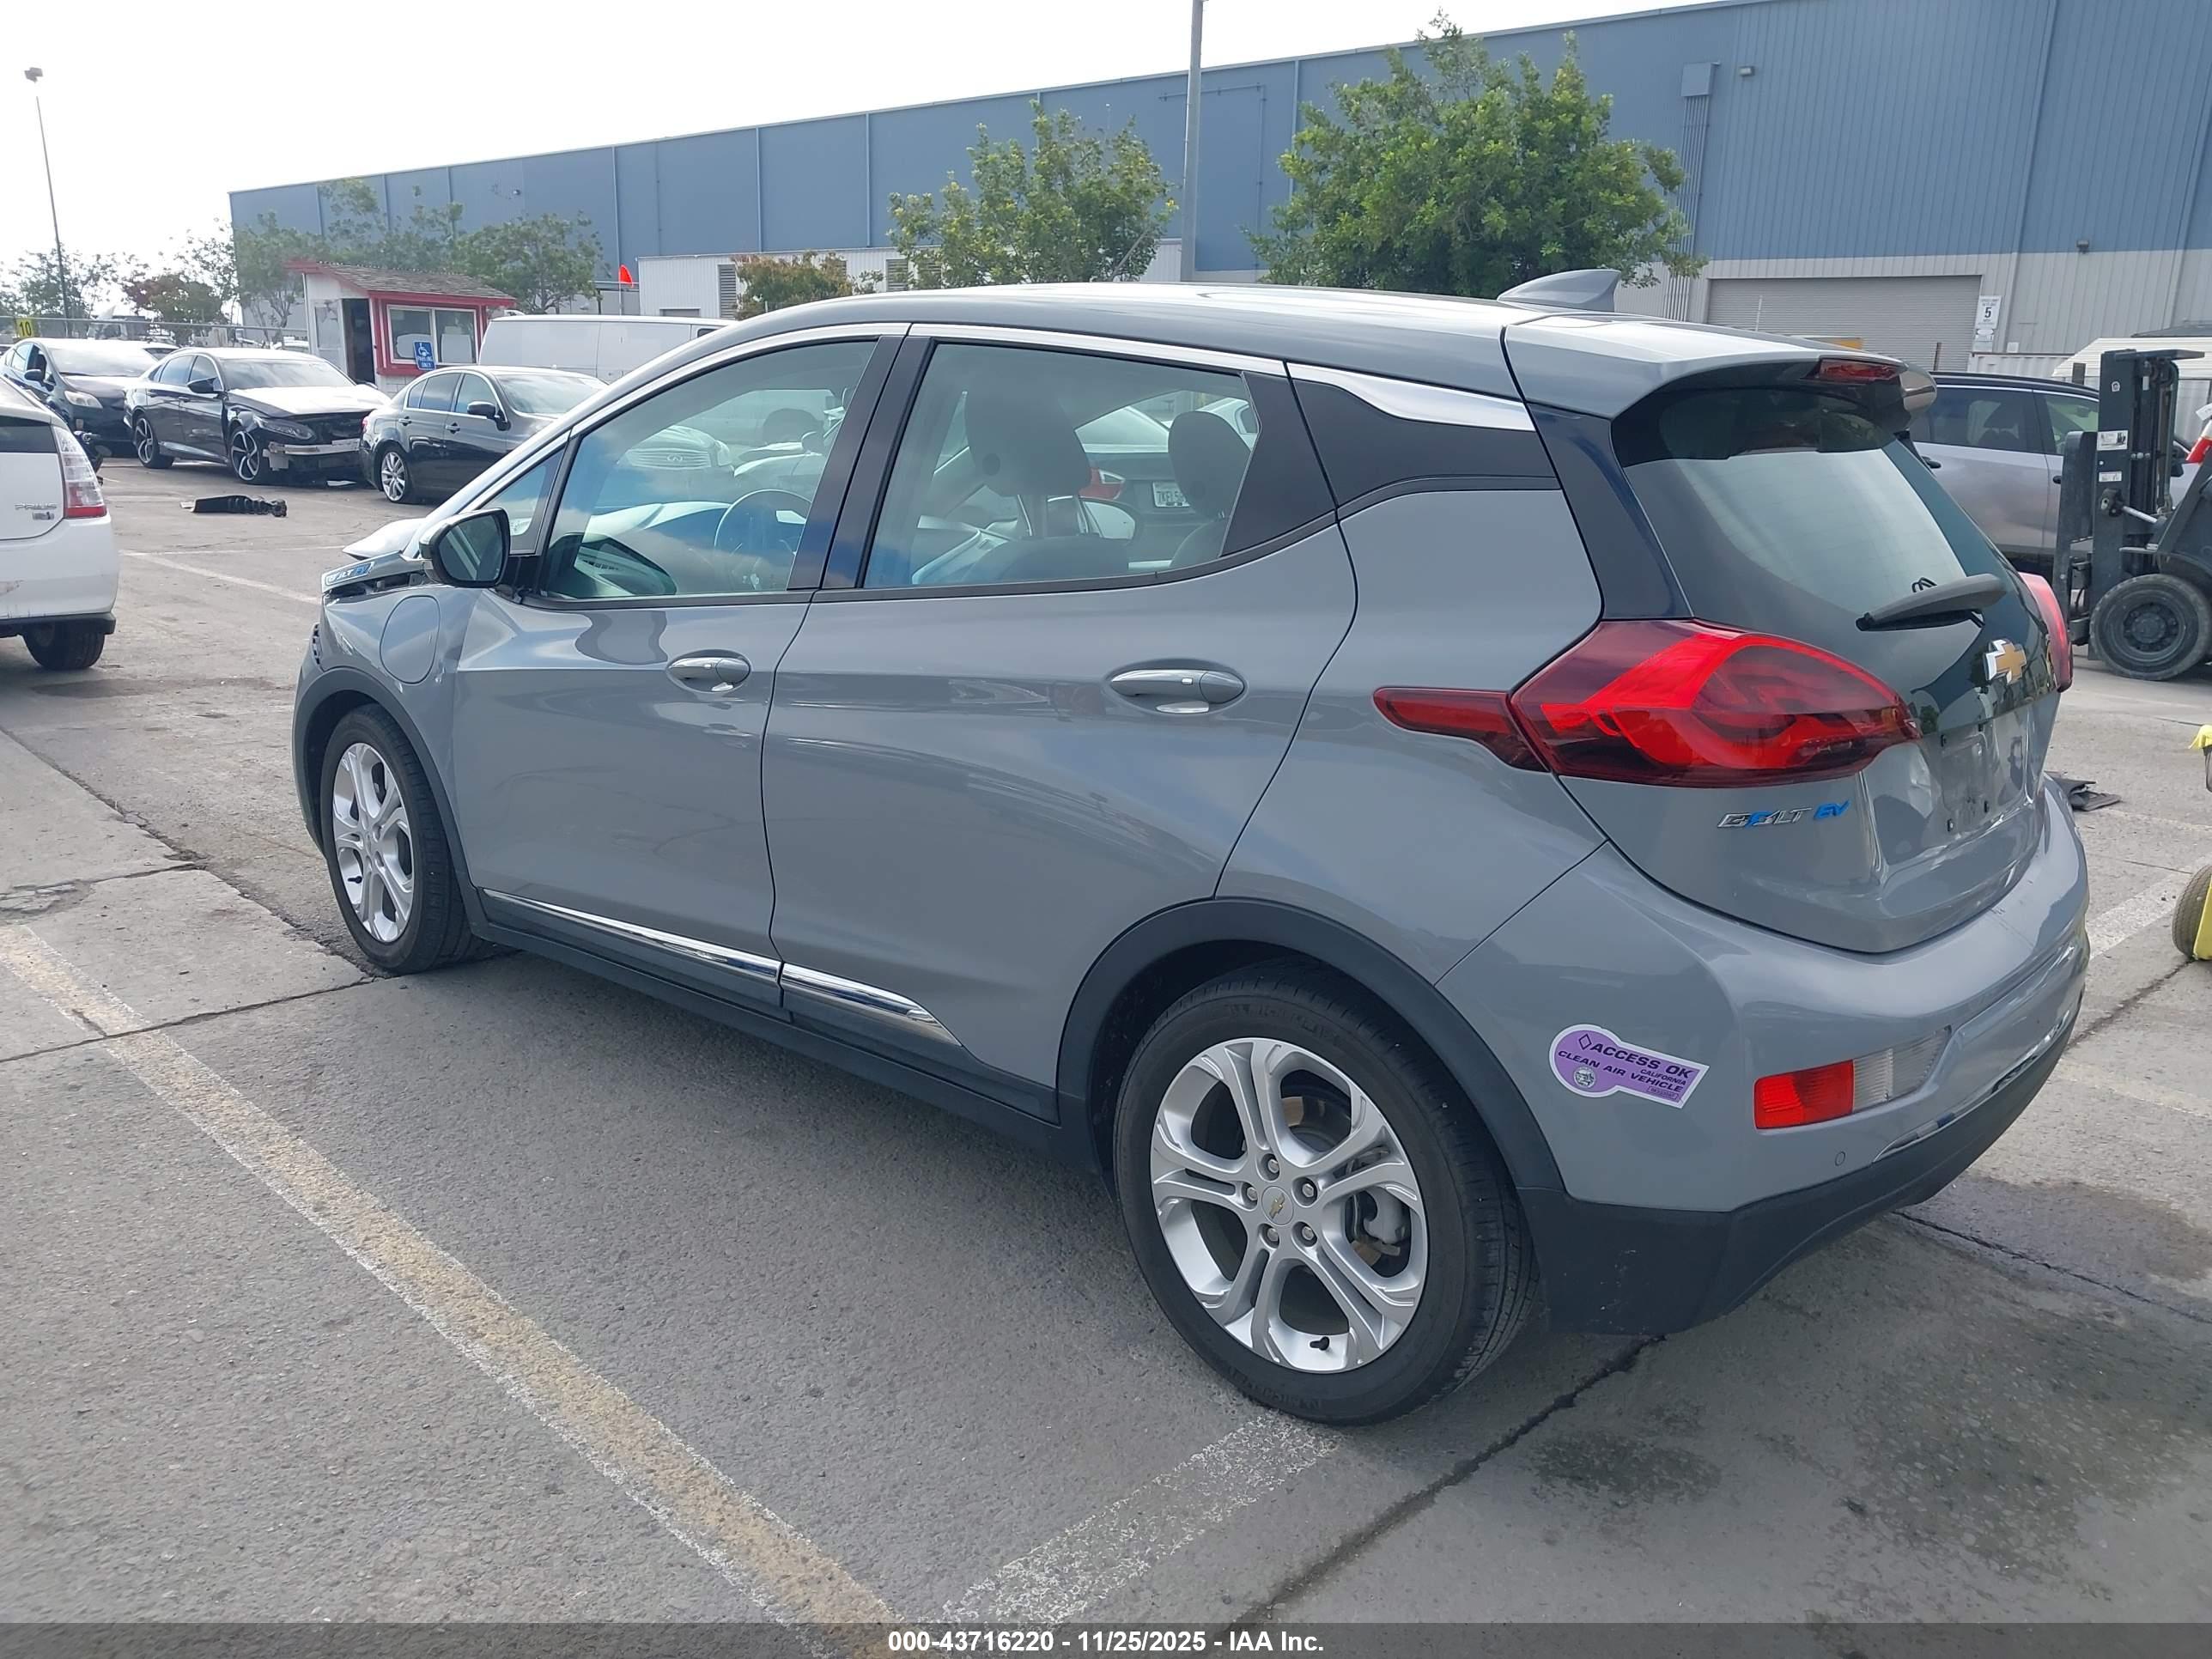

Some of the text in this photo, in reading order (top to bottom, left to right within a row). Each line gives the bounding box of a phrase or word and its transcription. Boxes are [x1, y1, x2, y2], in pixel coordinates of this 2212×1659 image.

[1984, 307, 1993, 319] 5
[19, 321, 32, 337] 10
[1717, 799, 1851, 828] BOLT EV
[1558, 1050, 1684, 1093] CLEAN AIR VEHICLE
[1590, 1043, 1694, 1079] ACCESS OK
[1640, 1069, 1686, 1086] CALIFORNIA
